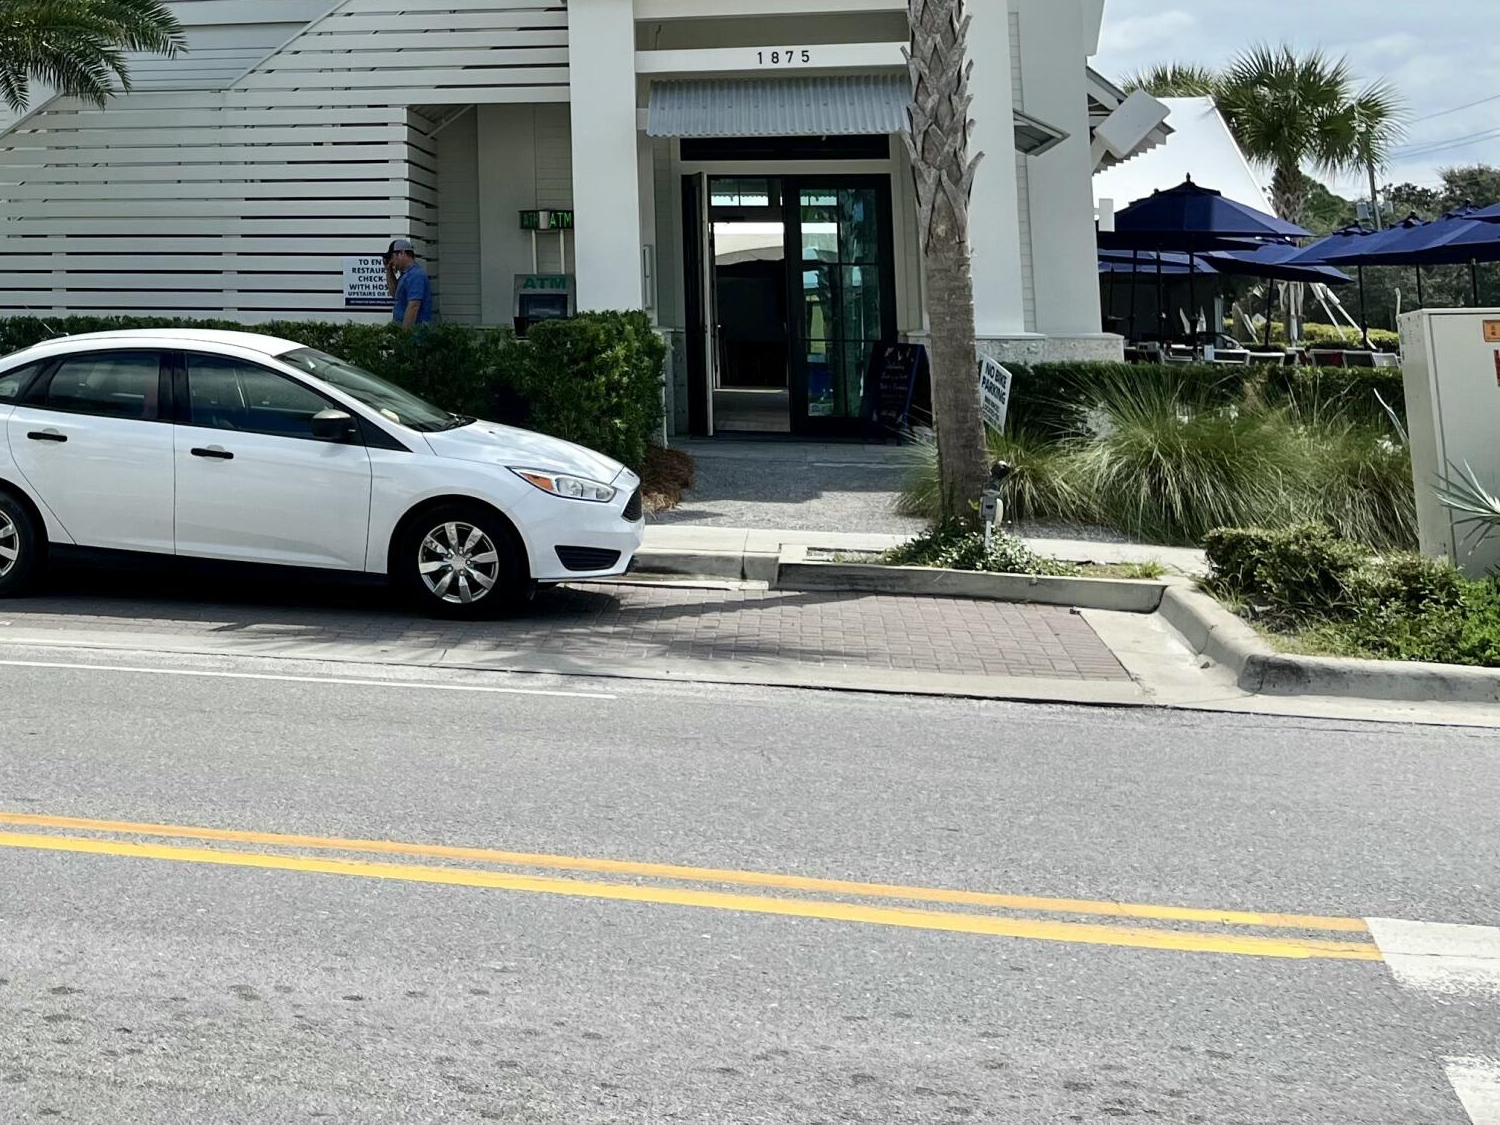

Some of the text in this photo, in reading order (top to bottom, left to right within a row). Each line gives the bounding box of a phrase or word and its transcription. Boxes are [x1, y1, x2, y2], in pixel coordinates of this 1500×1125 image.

[757, 50, 810, 64] 1875
[550, 211, 572, 229] ATM
[523, 277, 566, 290] ATM
[985, 361, 1007, 389] NO BIKE
[981, 375, 1006, 405] PARKING
